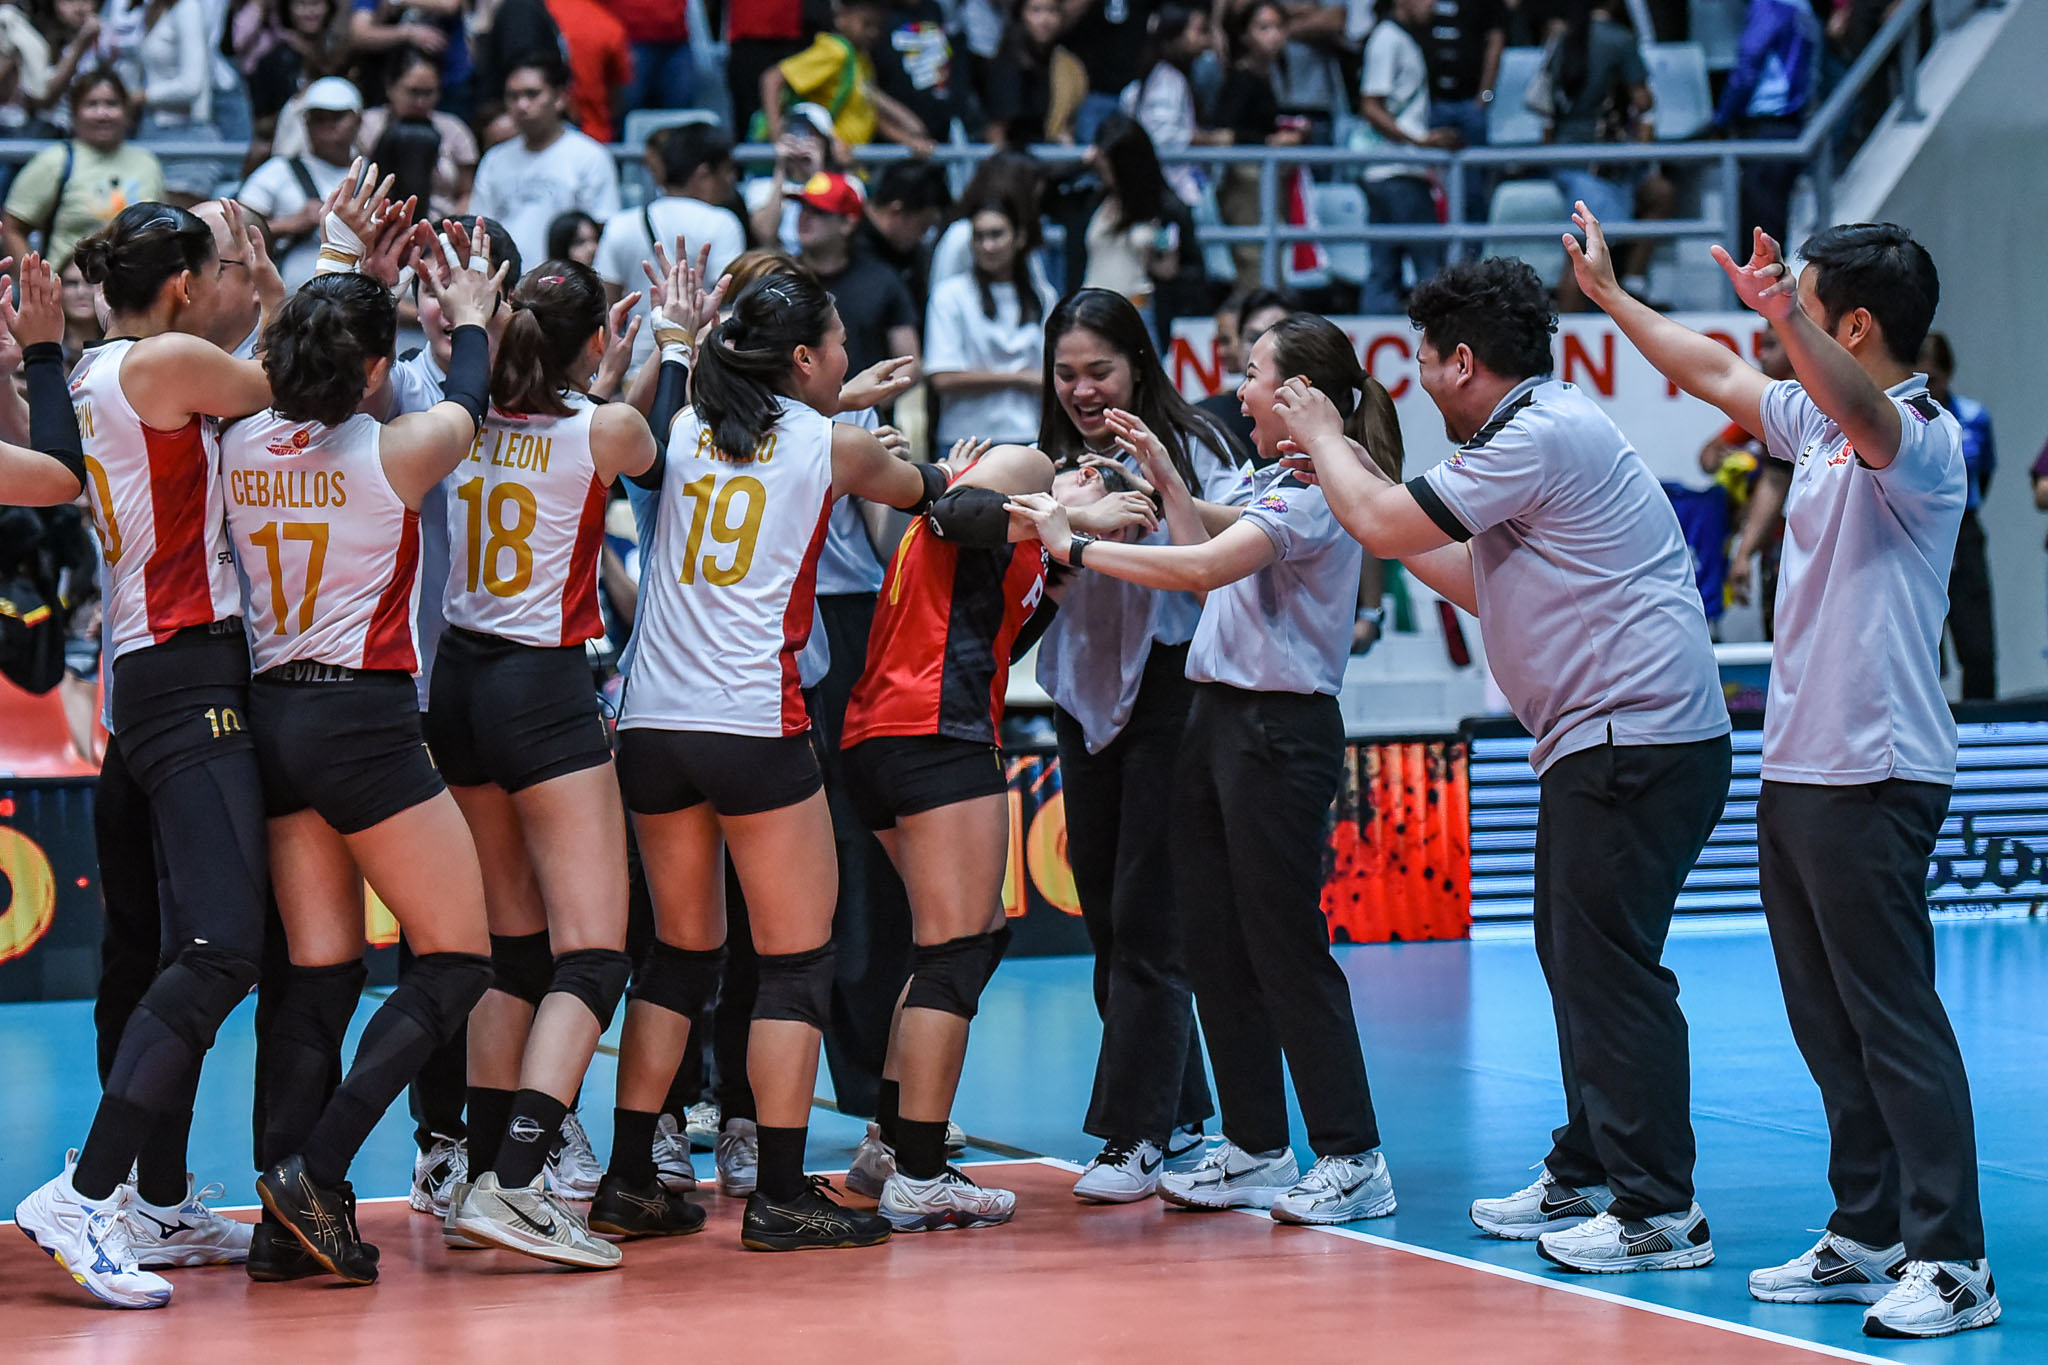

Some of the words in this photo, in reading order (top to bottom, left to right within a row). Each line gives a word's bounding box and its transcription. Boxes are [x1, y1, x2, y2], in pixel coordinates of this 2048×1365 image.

[230, 469, 347, 508] CEBALLOS
[463, 428, 489, 463] E
[491, 430, 552, 473] LEON
[248, 521, 329, 636] 17
[457, 476, 538, 598] 18
[678, 473, 767, 587] 19
